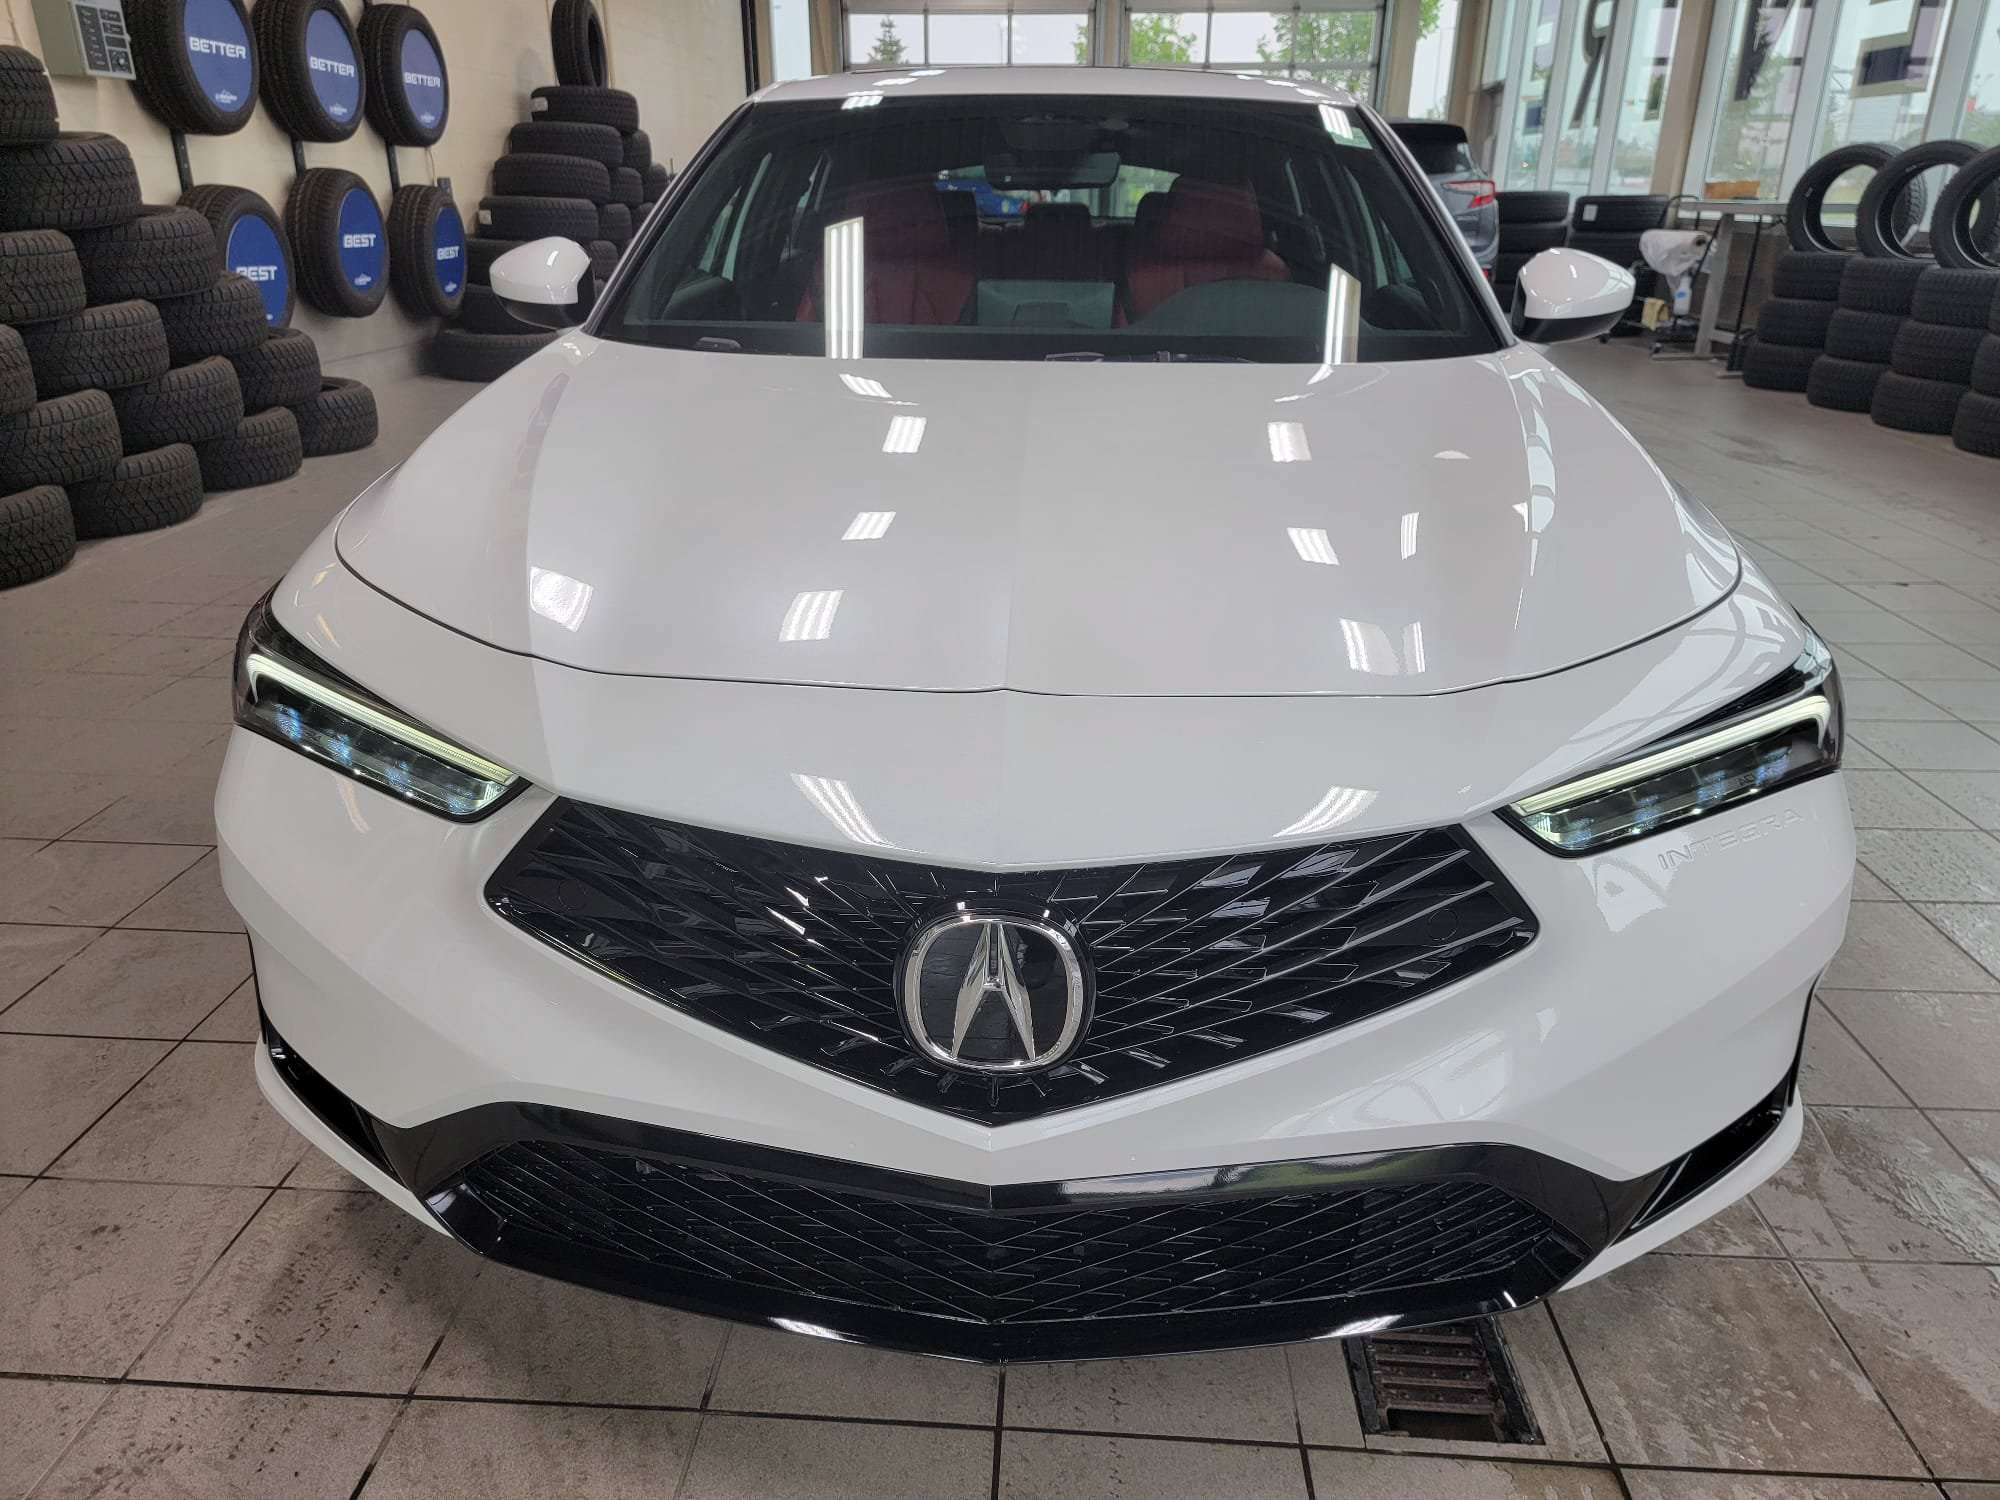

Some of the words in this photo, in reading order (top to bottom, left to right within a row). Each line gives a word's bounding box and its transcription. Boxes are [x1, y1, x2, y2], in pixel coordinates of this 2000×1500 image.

[189, 36, 247, 59] BETTER
[310, 56, 355, 78] BETTER
[404, 71, 441, 88] BETTER
[343, 234, 376, 249] BEST
[436, 246, 460, 260] BEST
